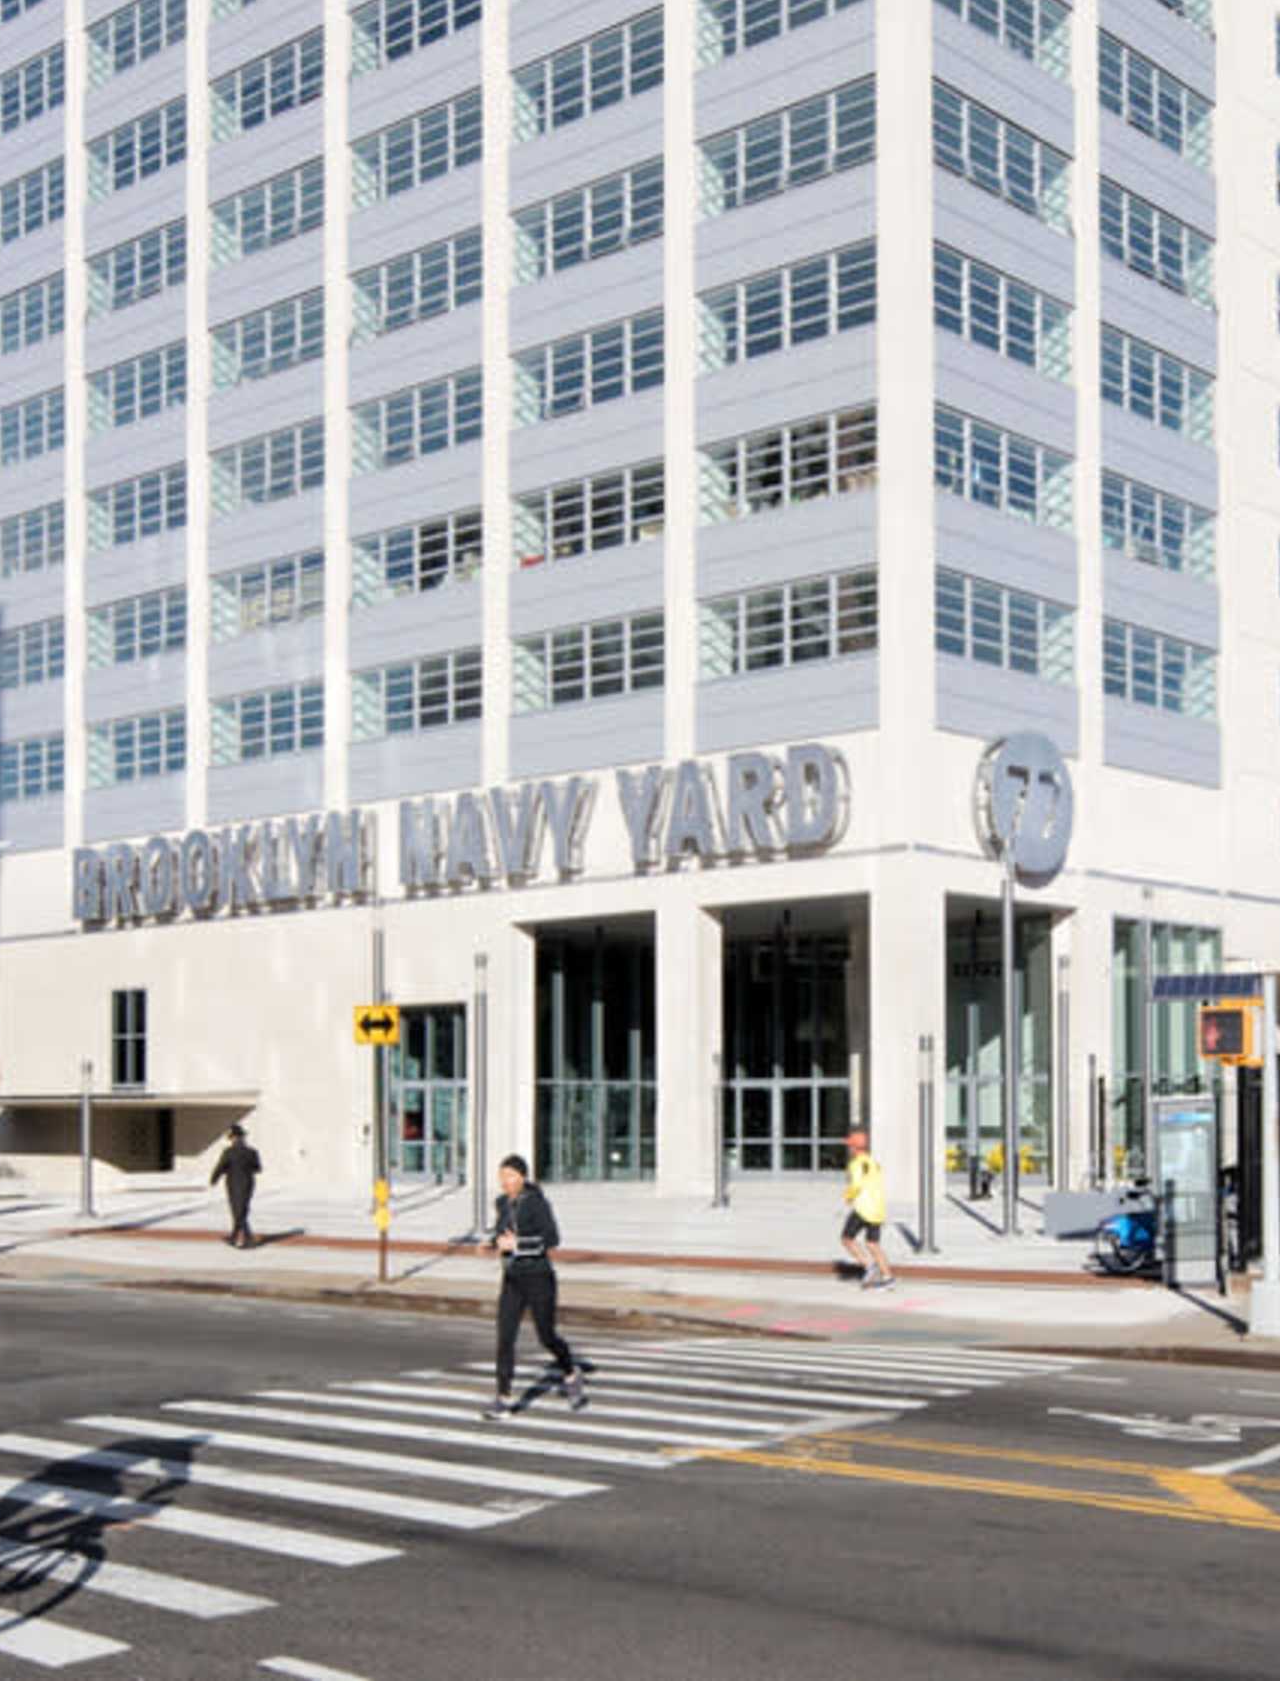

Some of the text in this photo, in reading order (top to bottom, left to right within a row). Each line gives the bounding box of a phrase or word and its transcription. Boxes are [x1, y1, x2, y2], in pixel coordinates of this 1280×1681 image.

[72, 744, 847, 924] BROOKLYN NAVY YARD
[1007, 766, 1061, 848] 77
